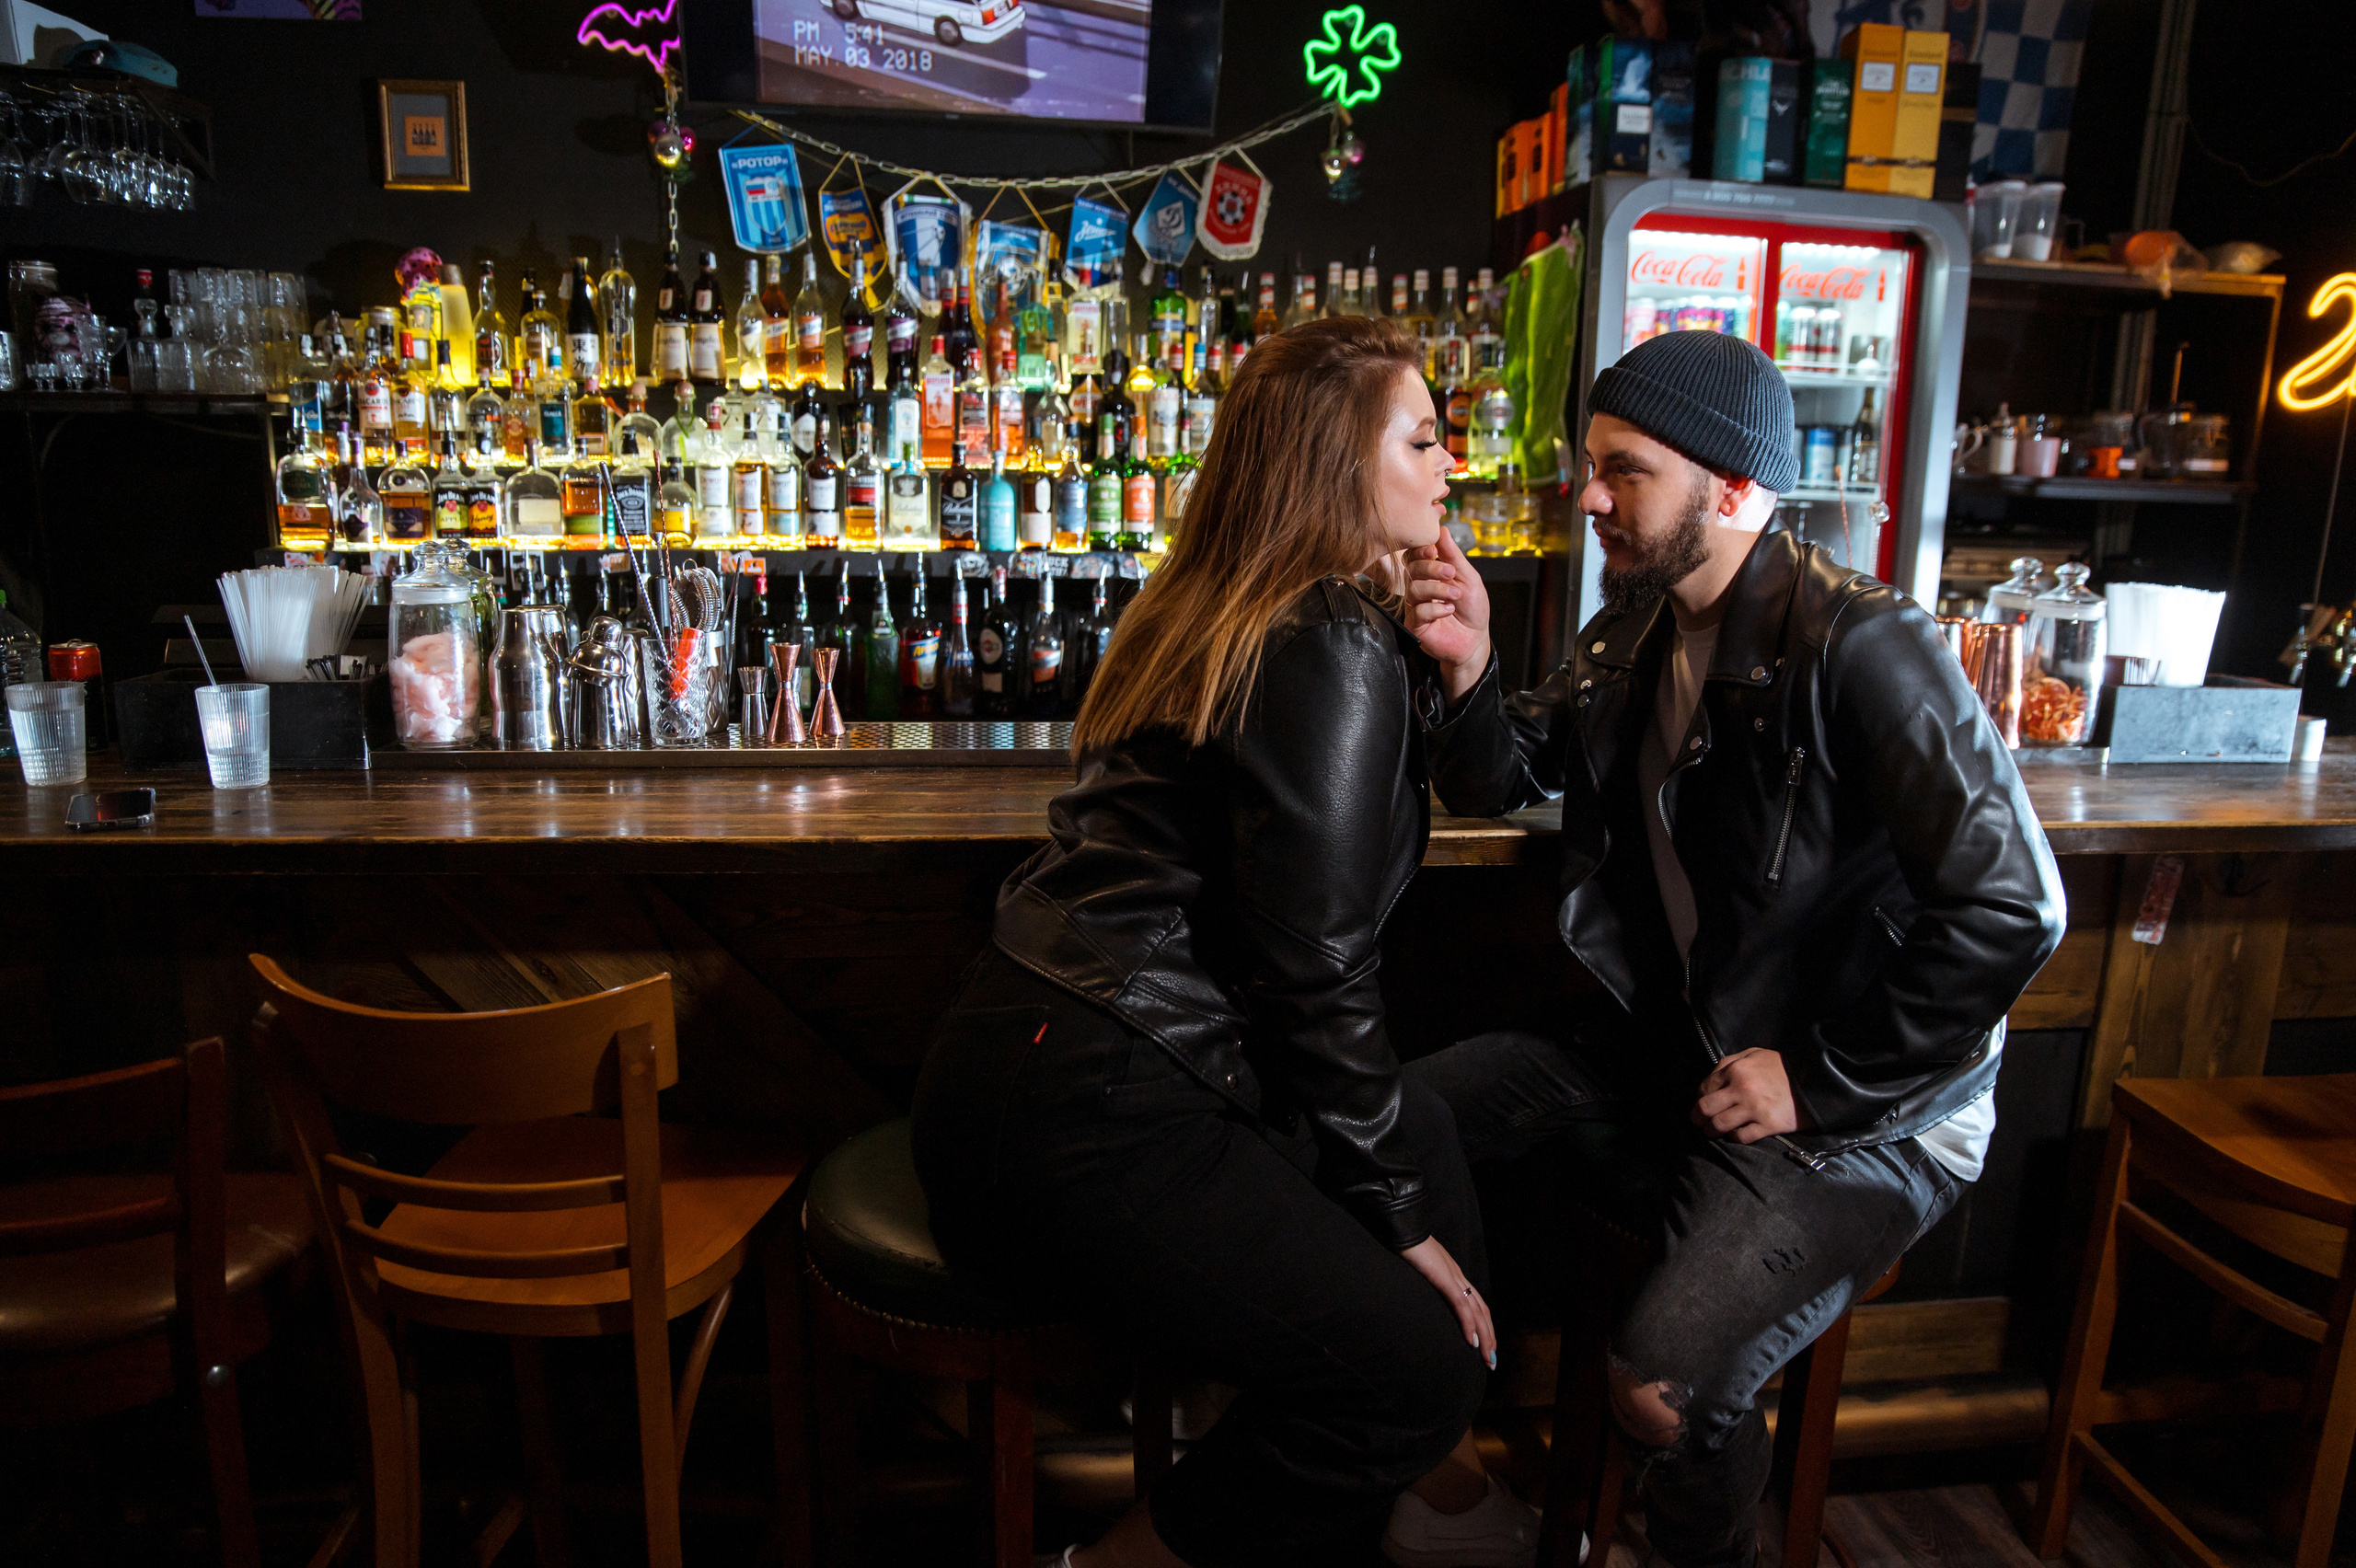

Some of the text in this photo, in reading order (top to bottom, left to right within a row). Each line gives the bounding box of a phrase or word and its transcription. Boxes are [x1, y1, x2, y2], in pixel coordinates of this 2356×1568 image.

[793, 19, 884, 46] PM 5:41
[794, 44, 933, 73] MAY 03 2018
[438, 492, 448, 505] JIM
[469, 492, 479, 504] JIM
[470, 513, 494, 525] Honey
